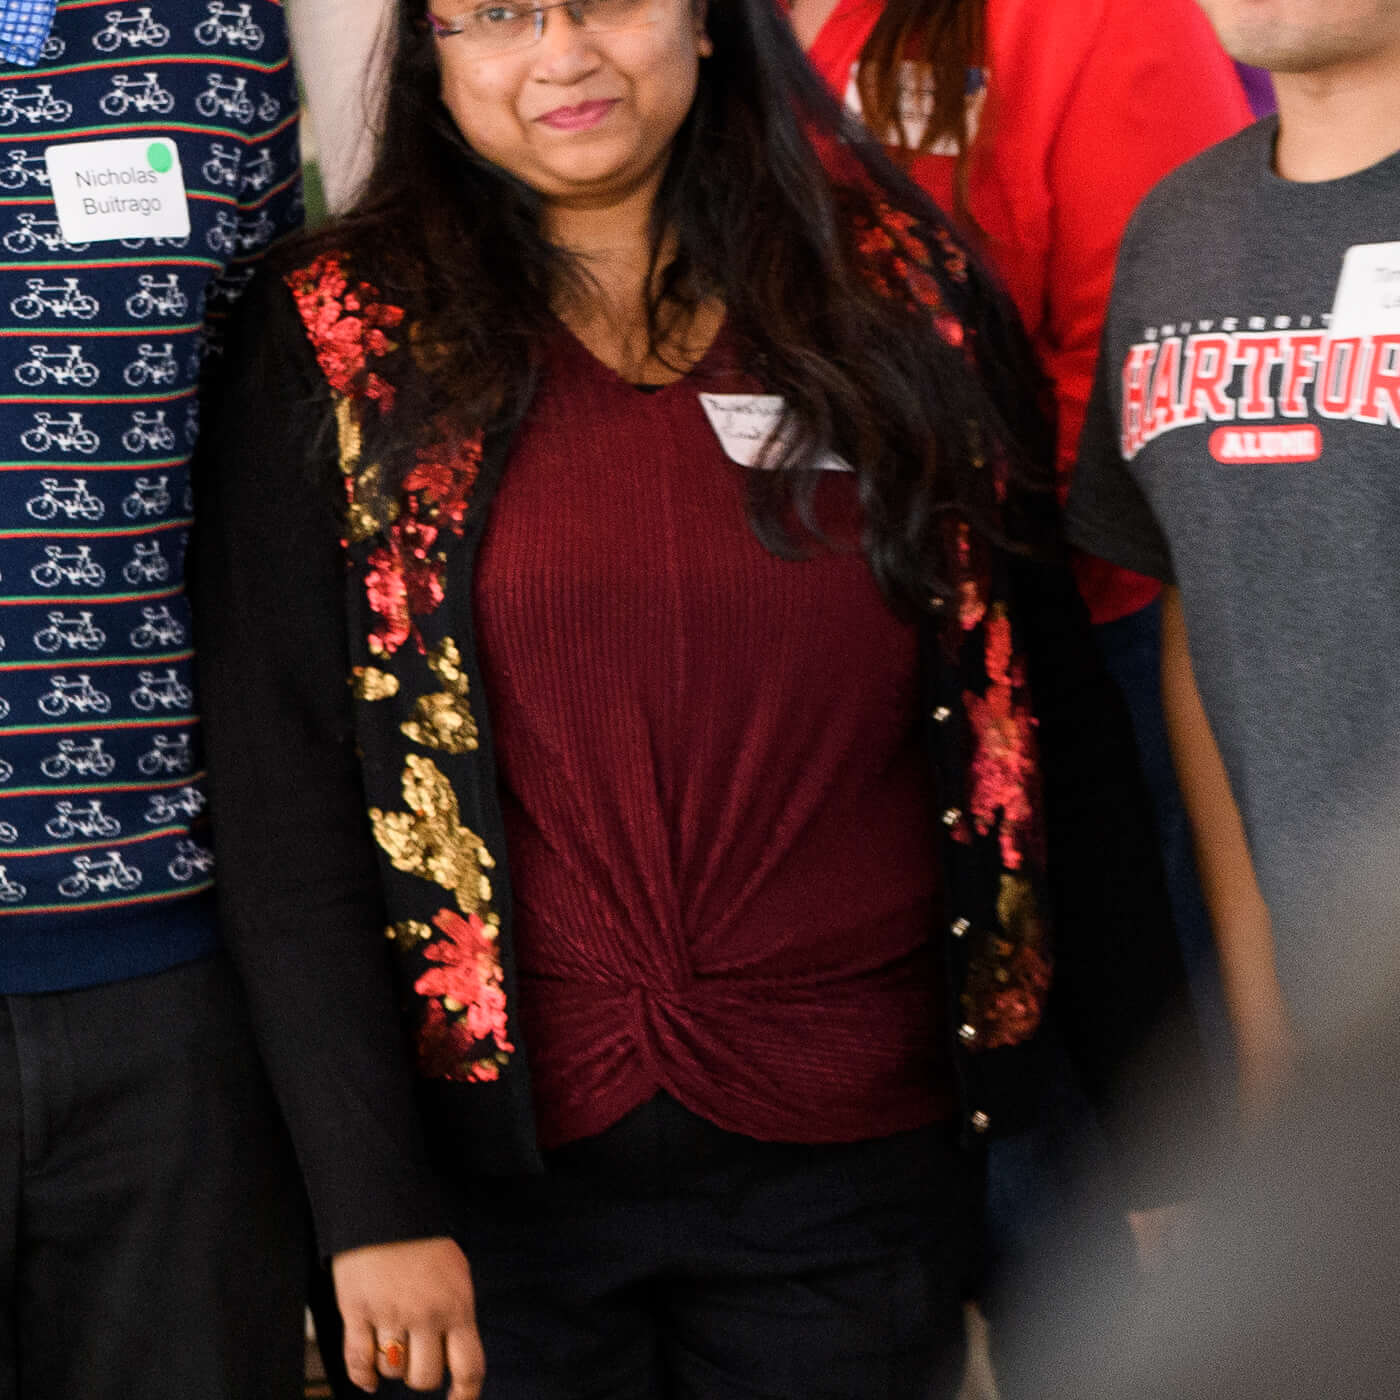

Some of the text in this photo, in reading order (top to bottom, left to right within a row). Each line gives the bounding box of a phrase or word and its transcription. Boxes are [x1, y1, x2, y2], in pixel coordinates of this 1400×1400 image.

[75, 168, 158, 188] Nicholas
[82, 197, 162, 216] Buitrago
[1144, 312, 1334, 341] UNIVERSIT
[1121, 330, 1400, 462] HARTFOR
